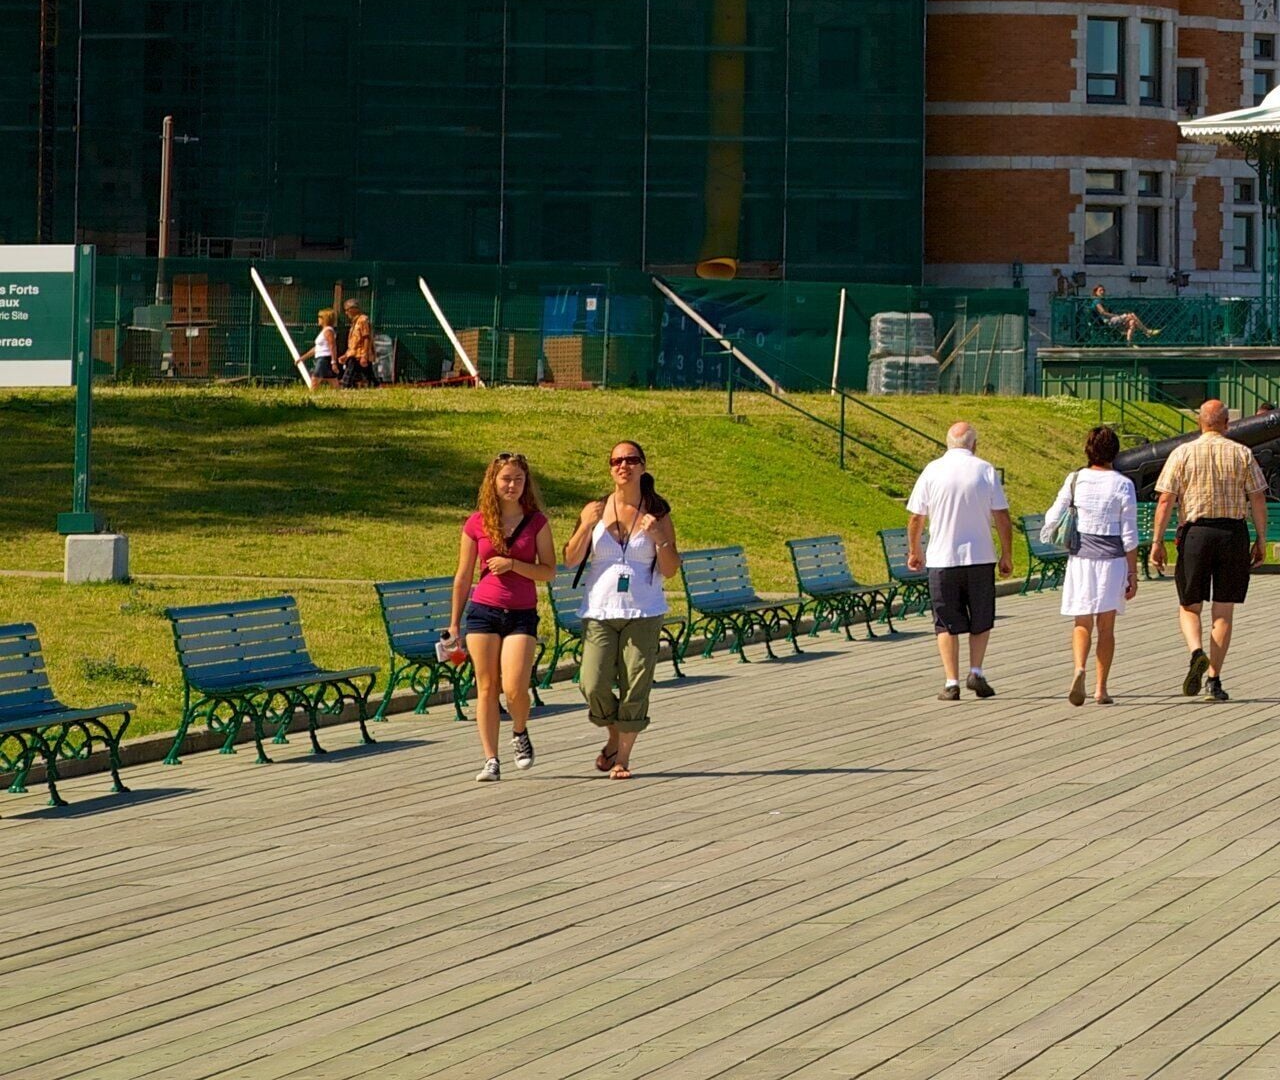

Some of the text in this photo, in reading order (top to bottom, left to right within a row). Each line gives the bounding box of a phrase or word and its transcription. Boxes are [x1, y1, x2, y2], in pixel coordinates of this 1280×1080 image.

[9, 284, 40, 295] Forts
[11, 311, 29, 320] Site
[0, 338, 33, 347] rrace
